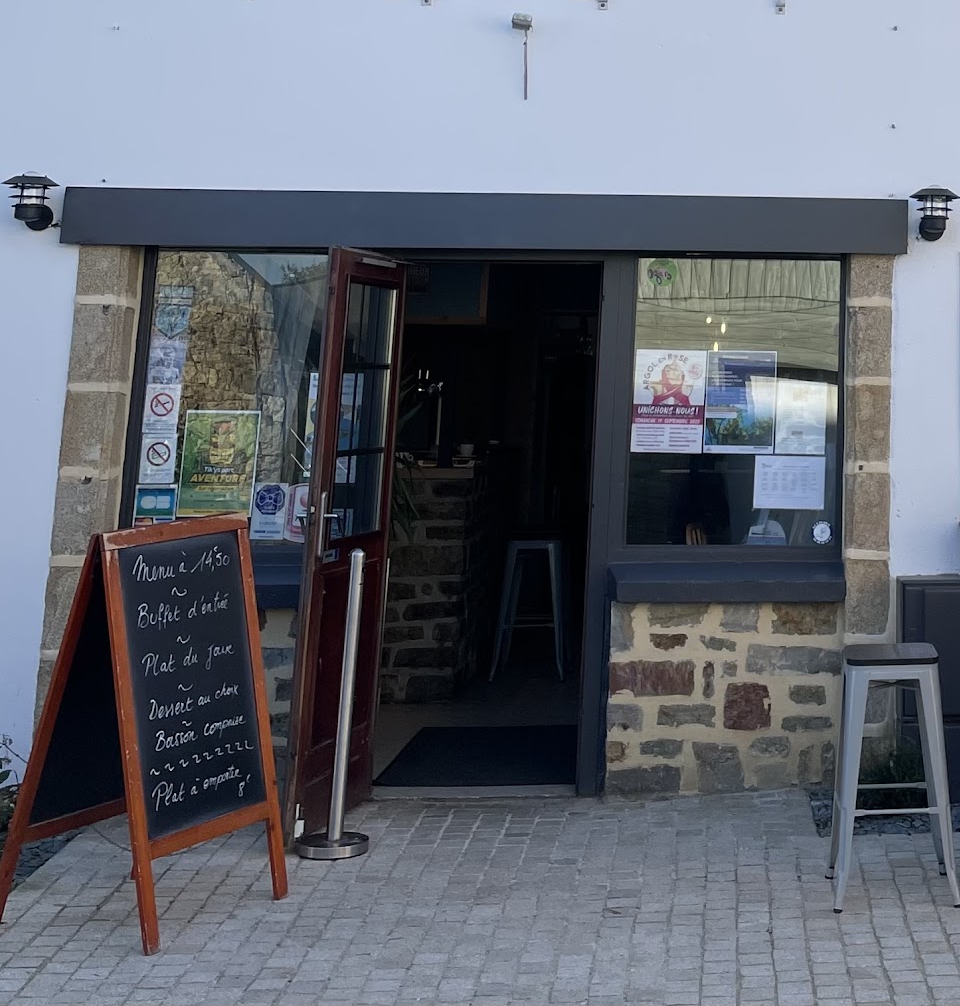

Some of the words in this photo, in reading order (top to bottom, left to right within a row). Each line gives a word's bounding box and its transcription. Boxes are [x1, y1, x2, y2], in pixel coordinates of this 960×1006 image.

[132, 554, 175, 582] Menu
[137, 603, 181, 630] Buffet
[141, 652, 176, 677] Plat
[183, 646, 198, 666] du
[149, 697, 194, 720] Dessert
[197, 695, 211, 706] au
[214, 682, 239, 700] choix
[151, 781, 186, 811] Plat
